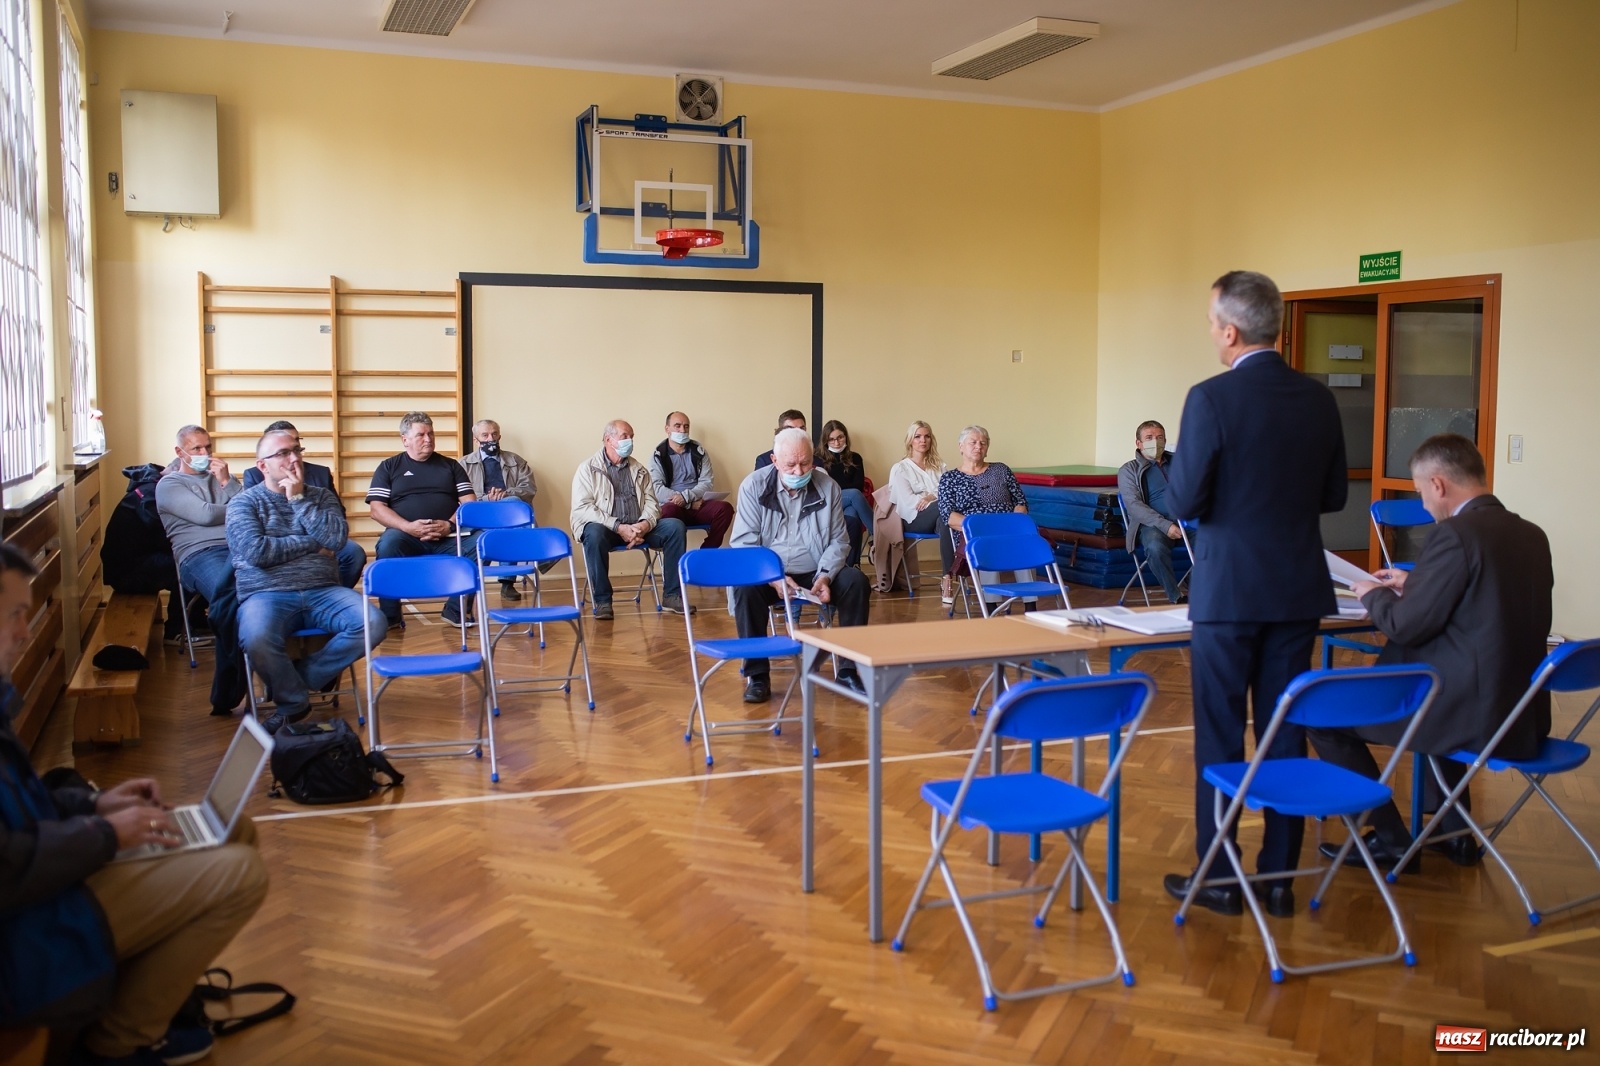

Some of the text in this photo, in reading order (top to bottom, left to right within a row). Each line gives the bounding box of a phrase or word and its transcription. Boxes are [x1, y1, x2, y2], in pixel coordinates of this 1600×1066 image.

[631, 131, 668, 139] TRANSFER
[1362, 256, 1398, 269] WYJŚCIE
[1360, 267, 1399, 278] EWAKUACYJNE
